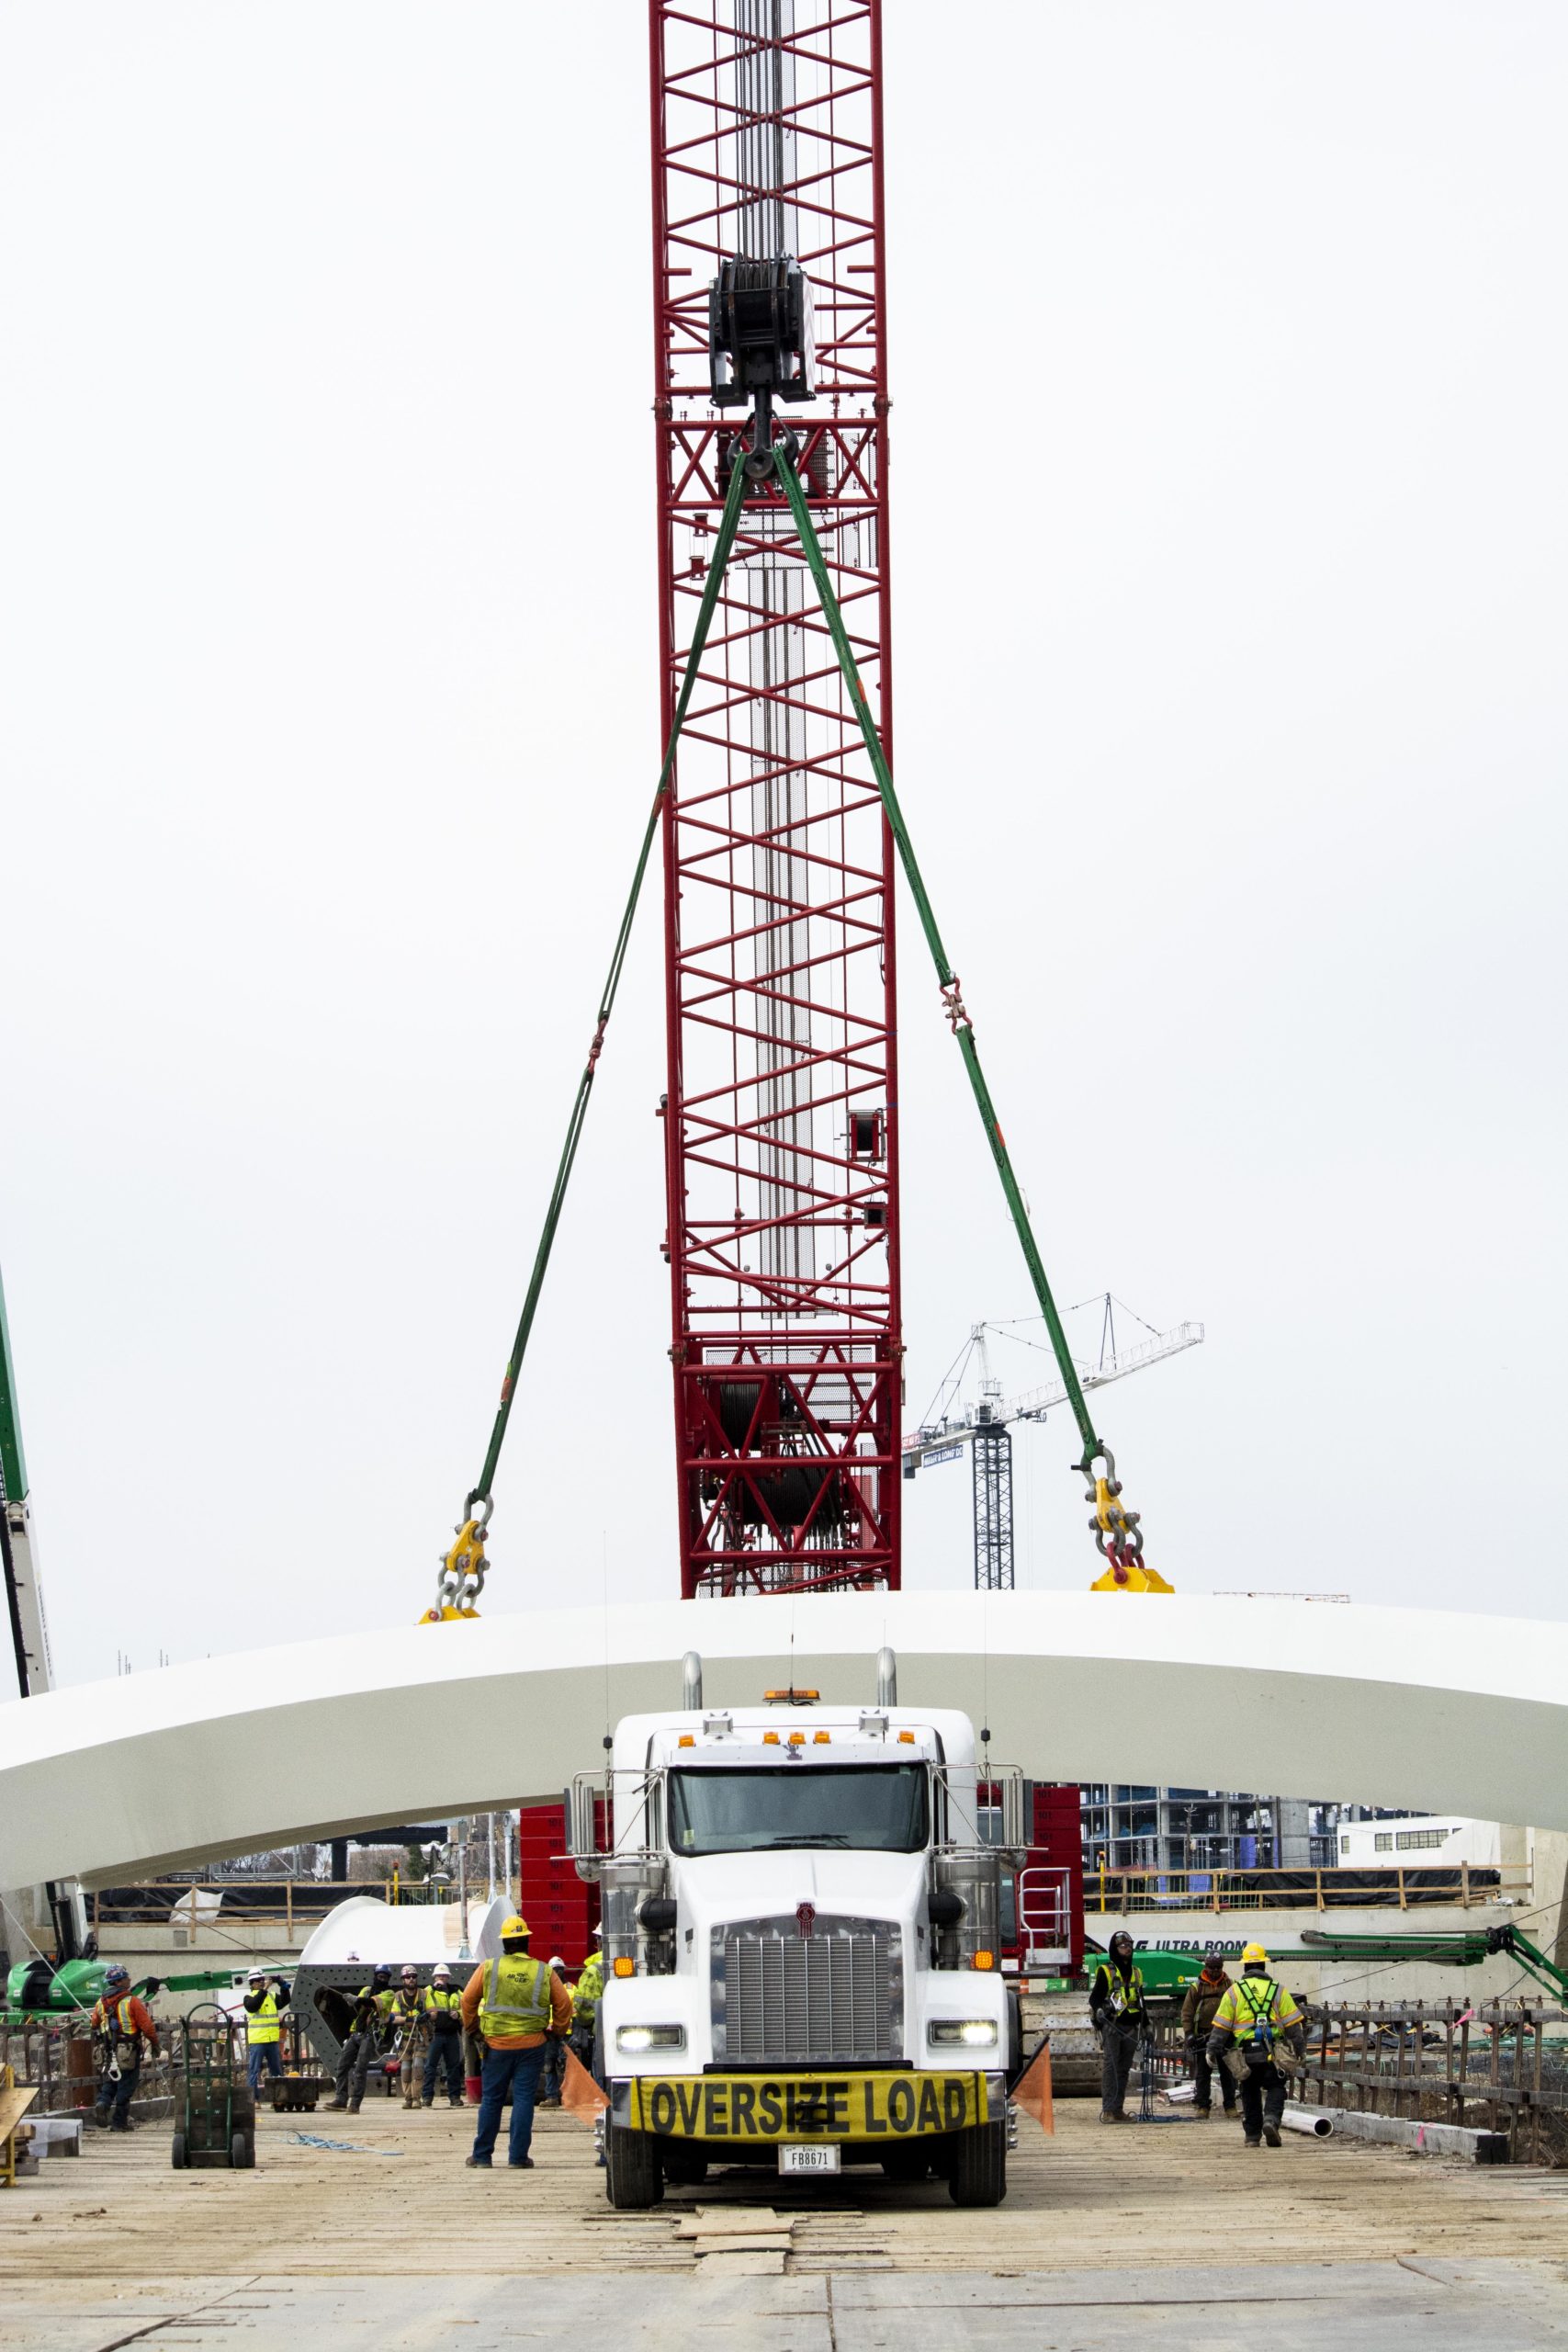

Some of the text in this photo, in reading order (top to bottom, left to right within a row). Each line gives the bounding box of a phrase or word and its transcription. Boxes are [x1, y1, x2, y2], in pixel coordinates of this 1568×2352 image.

[956, 1447, 963, 1456] DC
[1156, 1940, 1200, 1950] ULTRA
[1204, 1940, 1247, 1950] BOOM
[650, 2078, 967, 2135] OVERSIZE LOAD
[792, 2153, 828, 2165] FB8671
